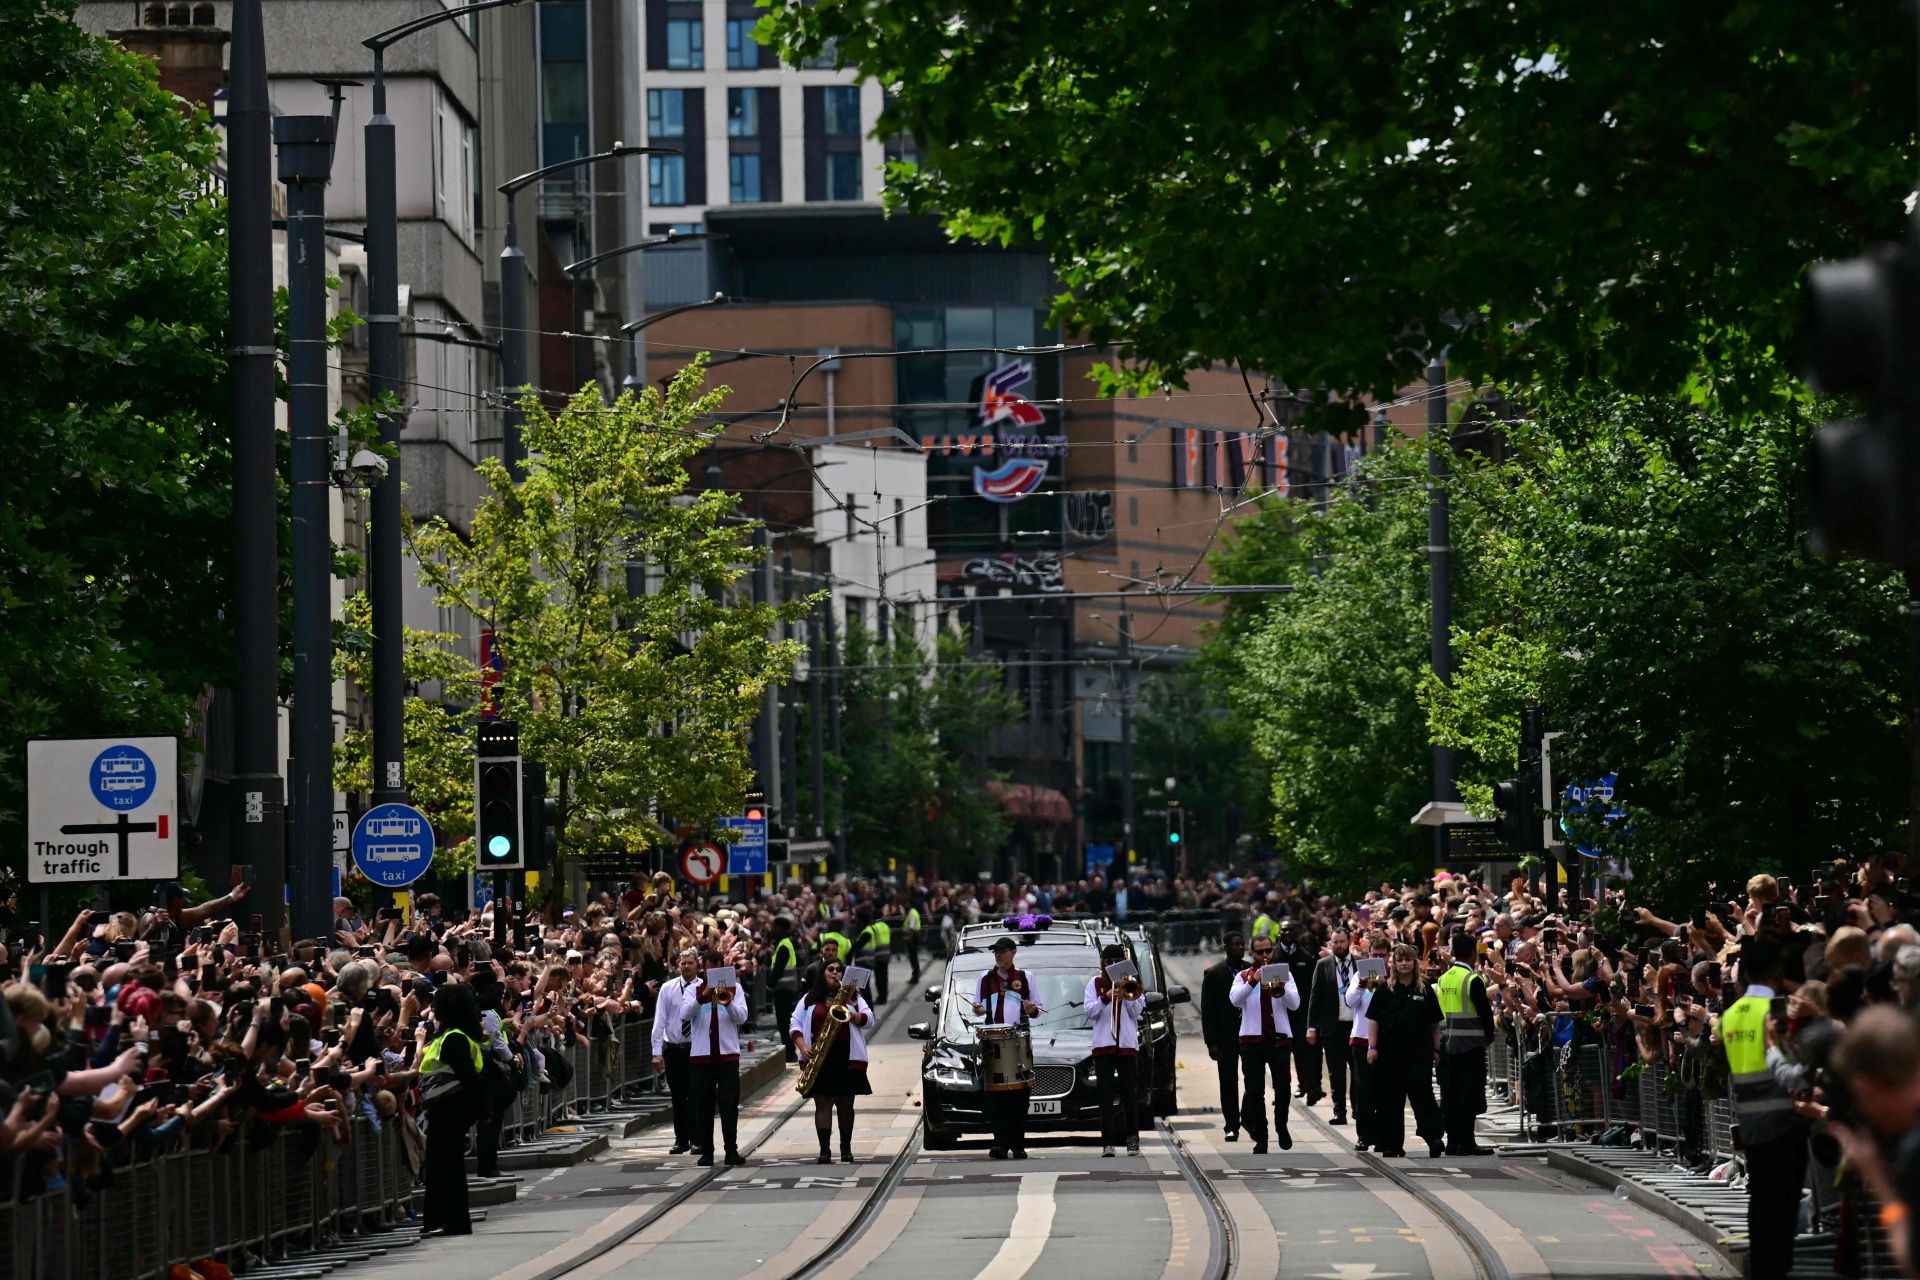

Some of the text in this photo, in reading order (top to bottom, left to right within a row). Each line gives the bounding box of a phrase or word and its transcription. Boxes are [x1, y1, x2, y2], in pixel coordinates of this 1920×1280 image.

[922, 434, 994, 457] FIVE
[1183, 427, 1290, 500] FIVE
[113, 795, 133, 805] taxi
[250, 803, 258, 811] 21
[34, 839, 109, 857] Through
[43, 858, 101, 875] traffic
[382, 869, 405, 881] taxi
[1034, 1102, 1054, 1112] DVJ
